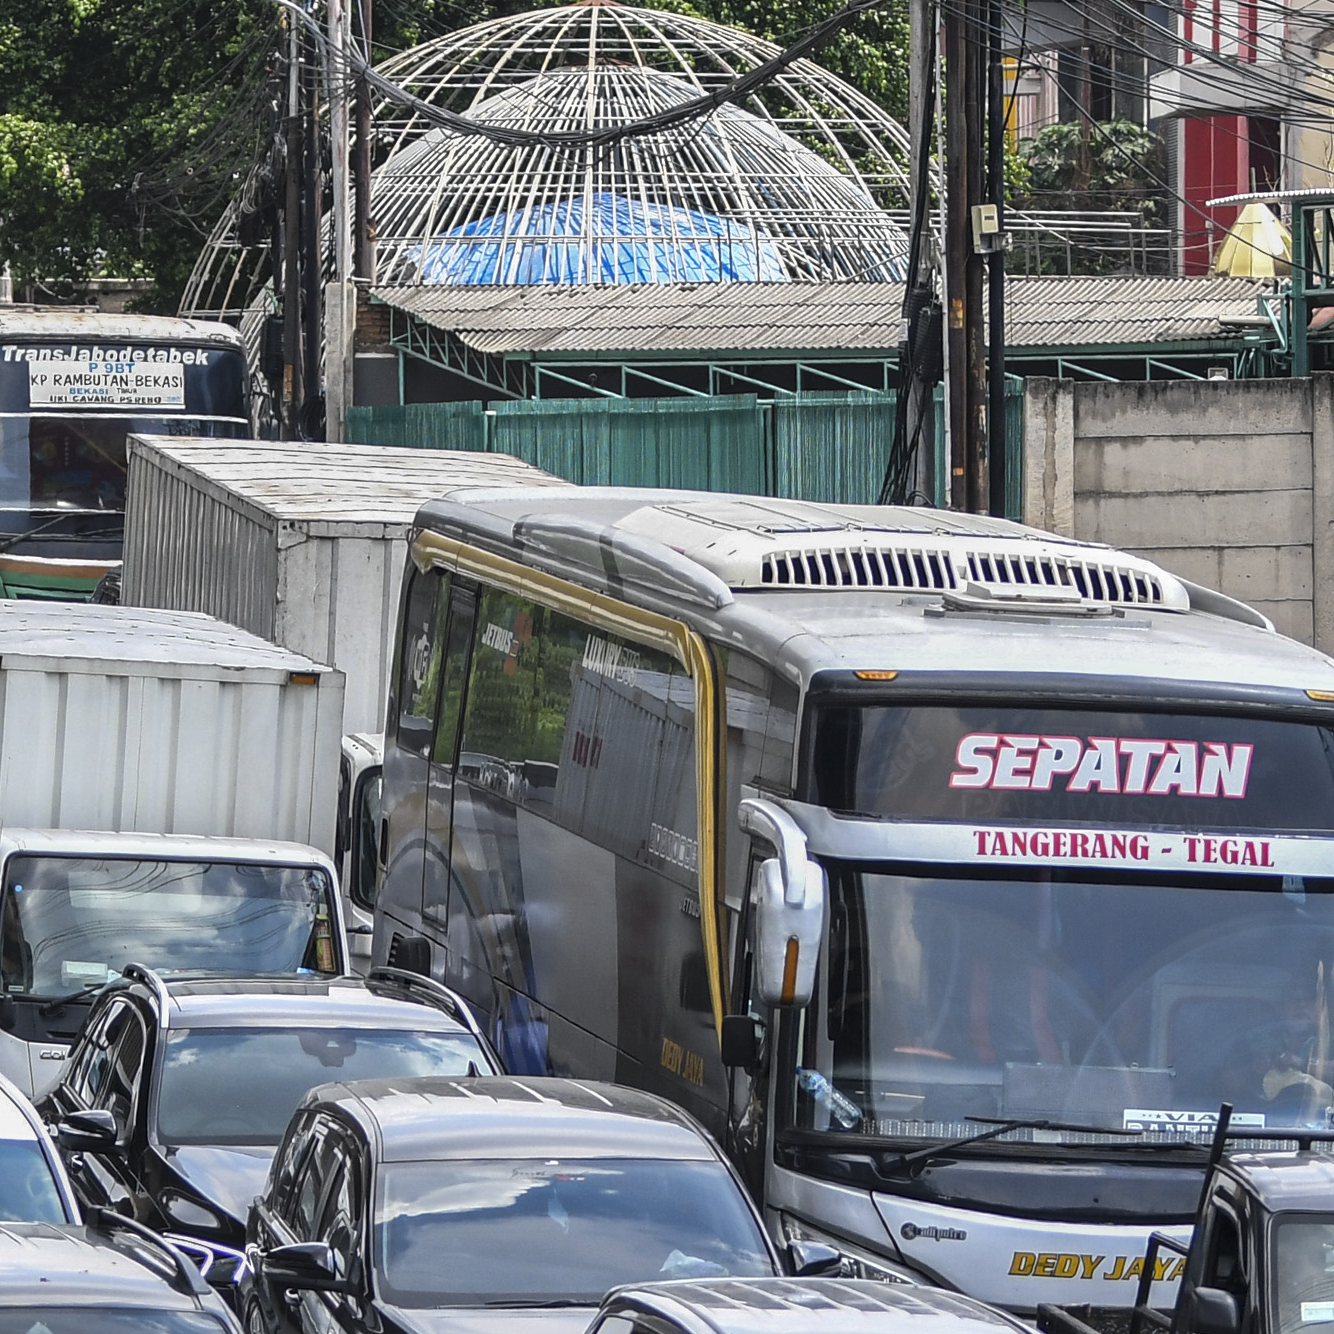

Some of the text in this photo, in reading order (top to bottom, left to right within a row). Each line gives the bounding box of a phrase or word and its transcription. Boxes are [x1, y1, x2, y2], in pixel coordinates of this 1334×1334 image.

[2, 345, 209, 366] TransJabodetabek
[89, 363, 136, 374] P 9BT
[31, 374, 183, 388] KP RAMBUTAN-BEKASI
[949, 732, 1254, 799] SEPATAN
[973, 830, 1150, 861] TANGERANG
[1183, 837, 1275, 868] TEGAL
[660, 1037, 704, 1087] DEDY JAYA
[1164, 1112, 1218, 1122] VIA
[1008, 1252, 1106, 1279] DEDY
